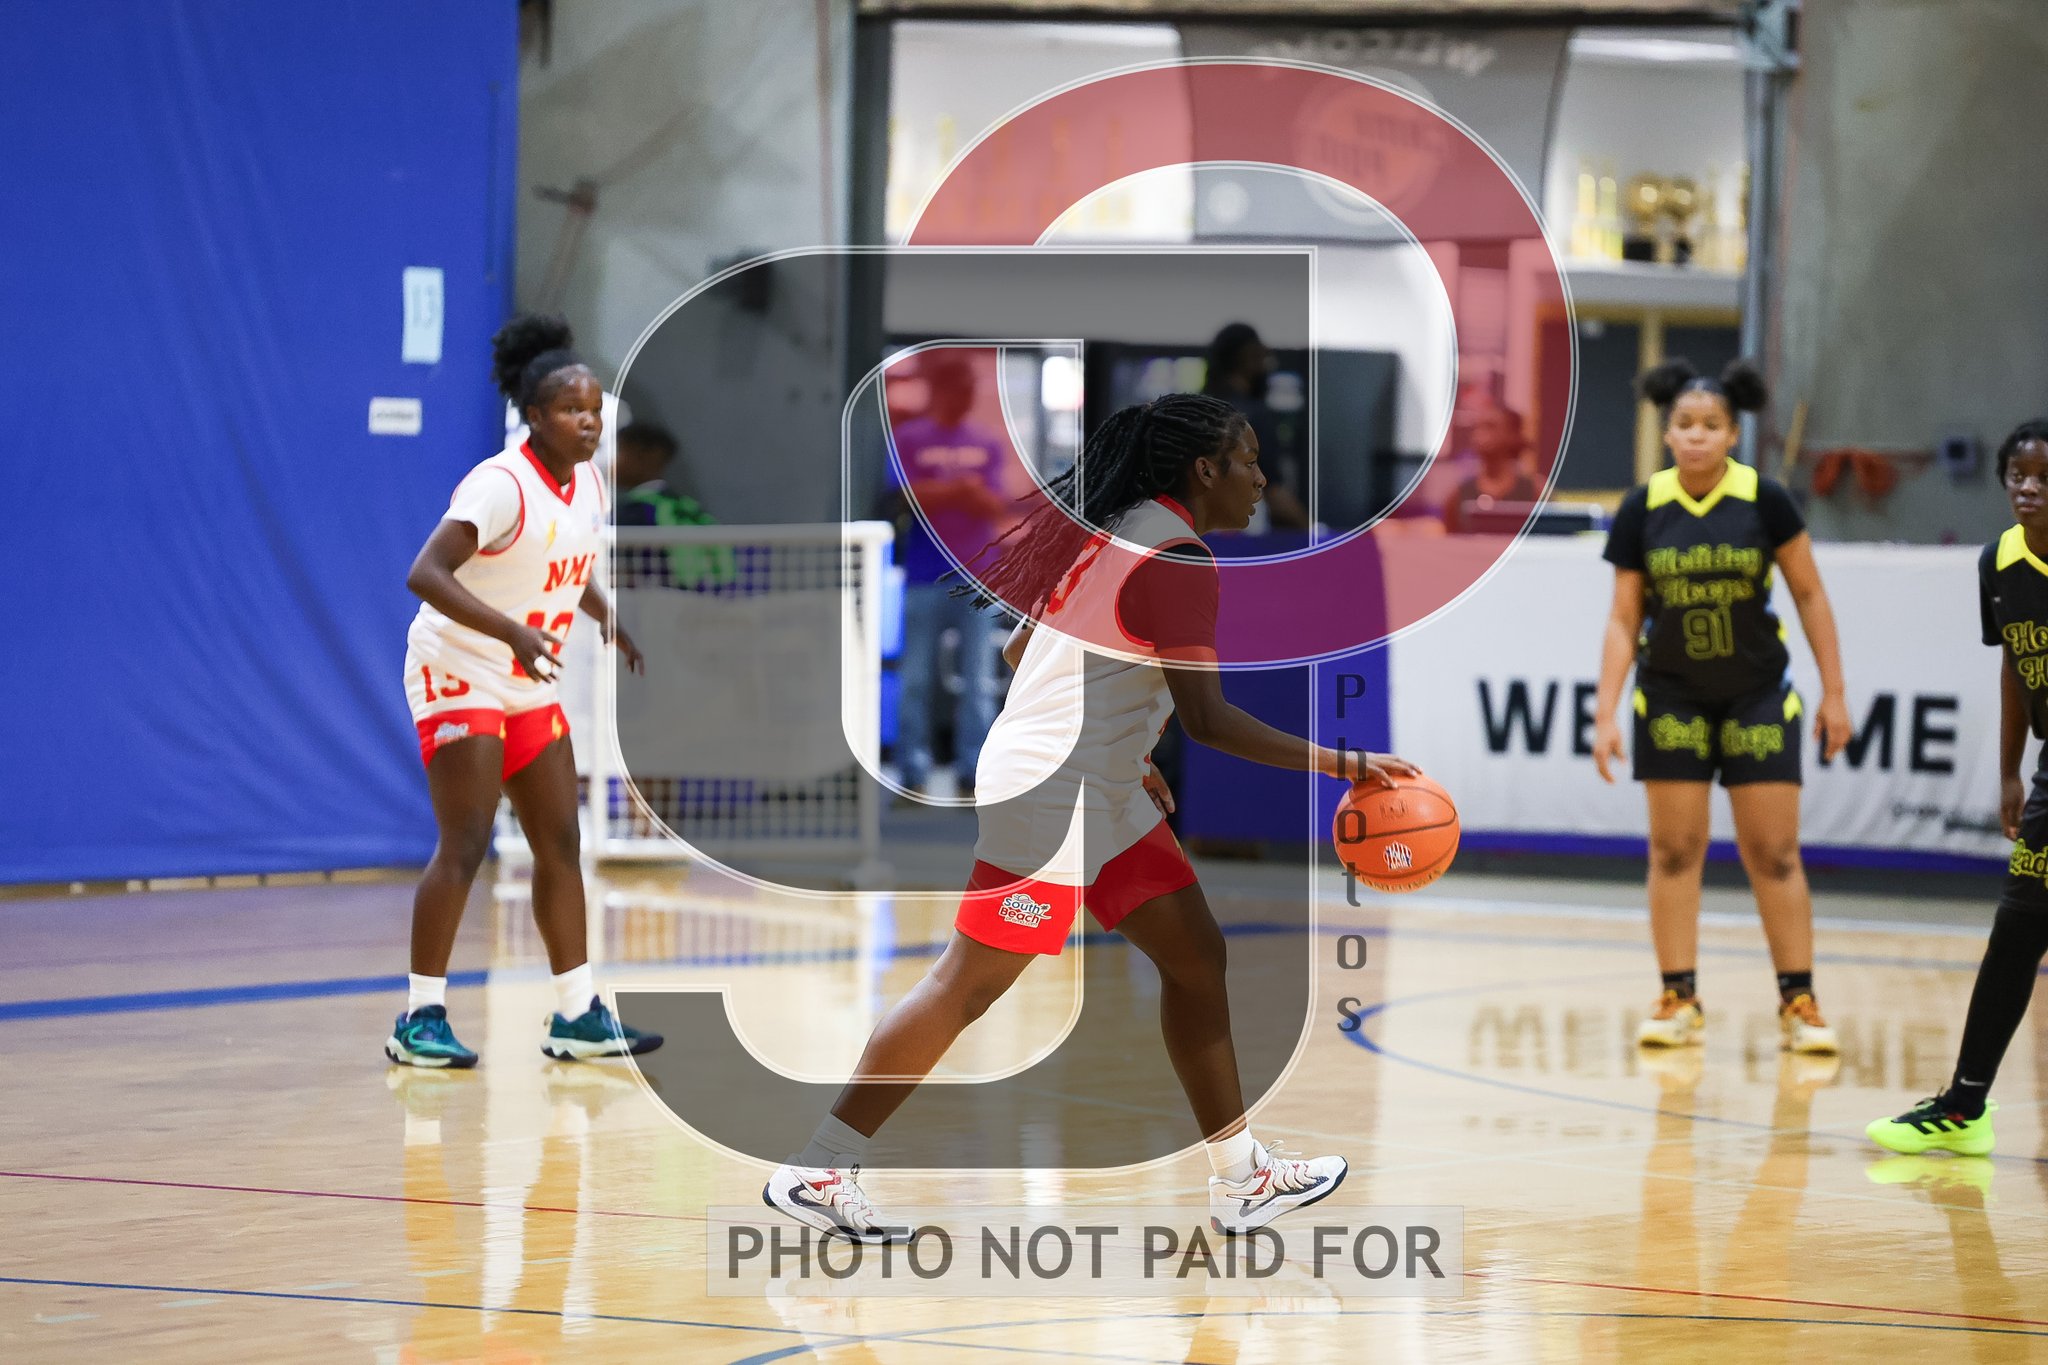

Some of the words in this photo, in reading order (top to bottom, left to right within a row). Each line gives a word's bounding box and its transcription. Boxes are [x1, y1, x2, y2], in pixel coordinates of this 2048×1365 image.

[1682, 608, 1734, 659] 91
[1004, 897, 1041, 915] South
[999, 907, 1040, 924] Beach
